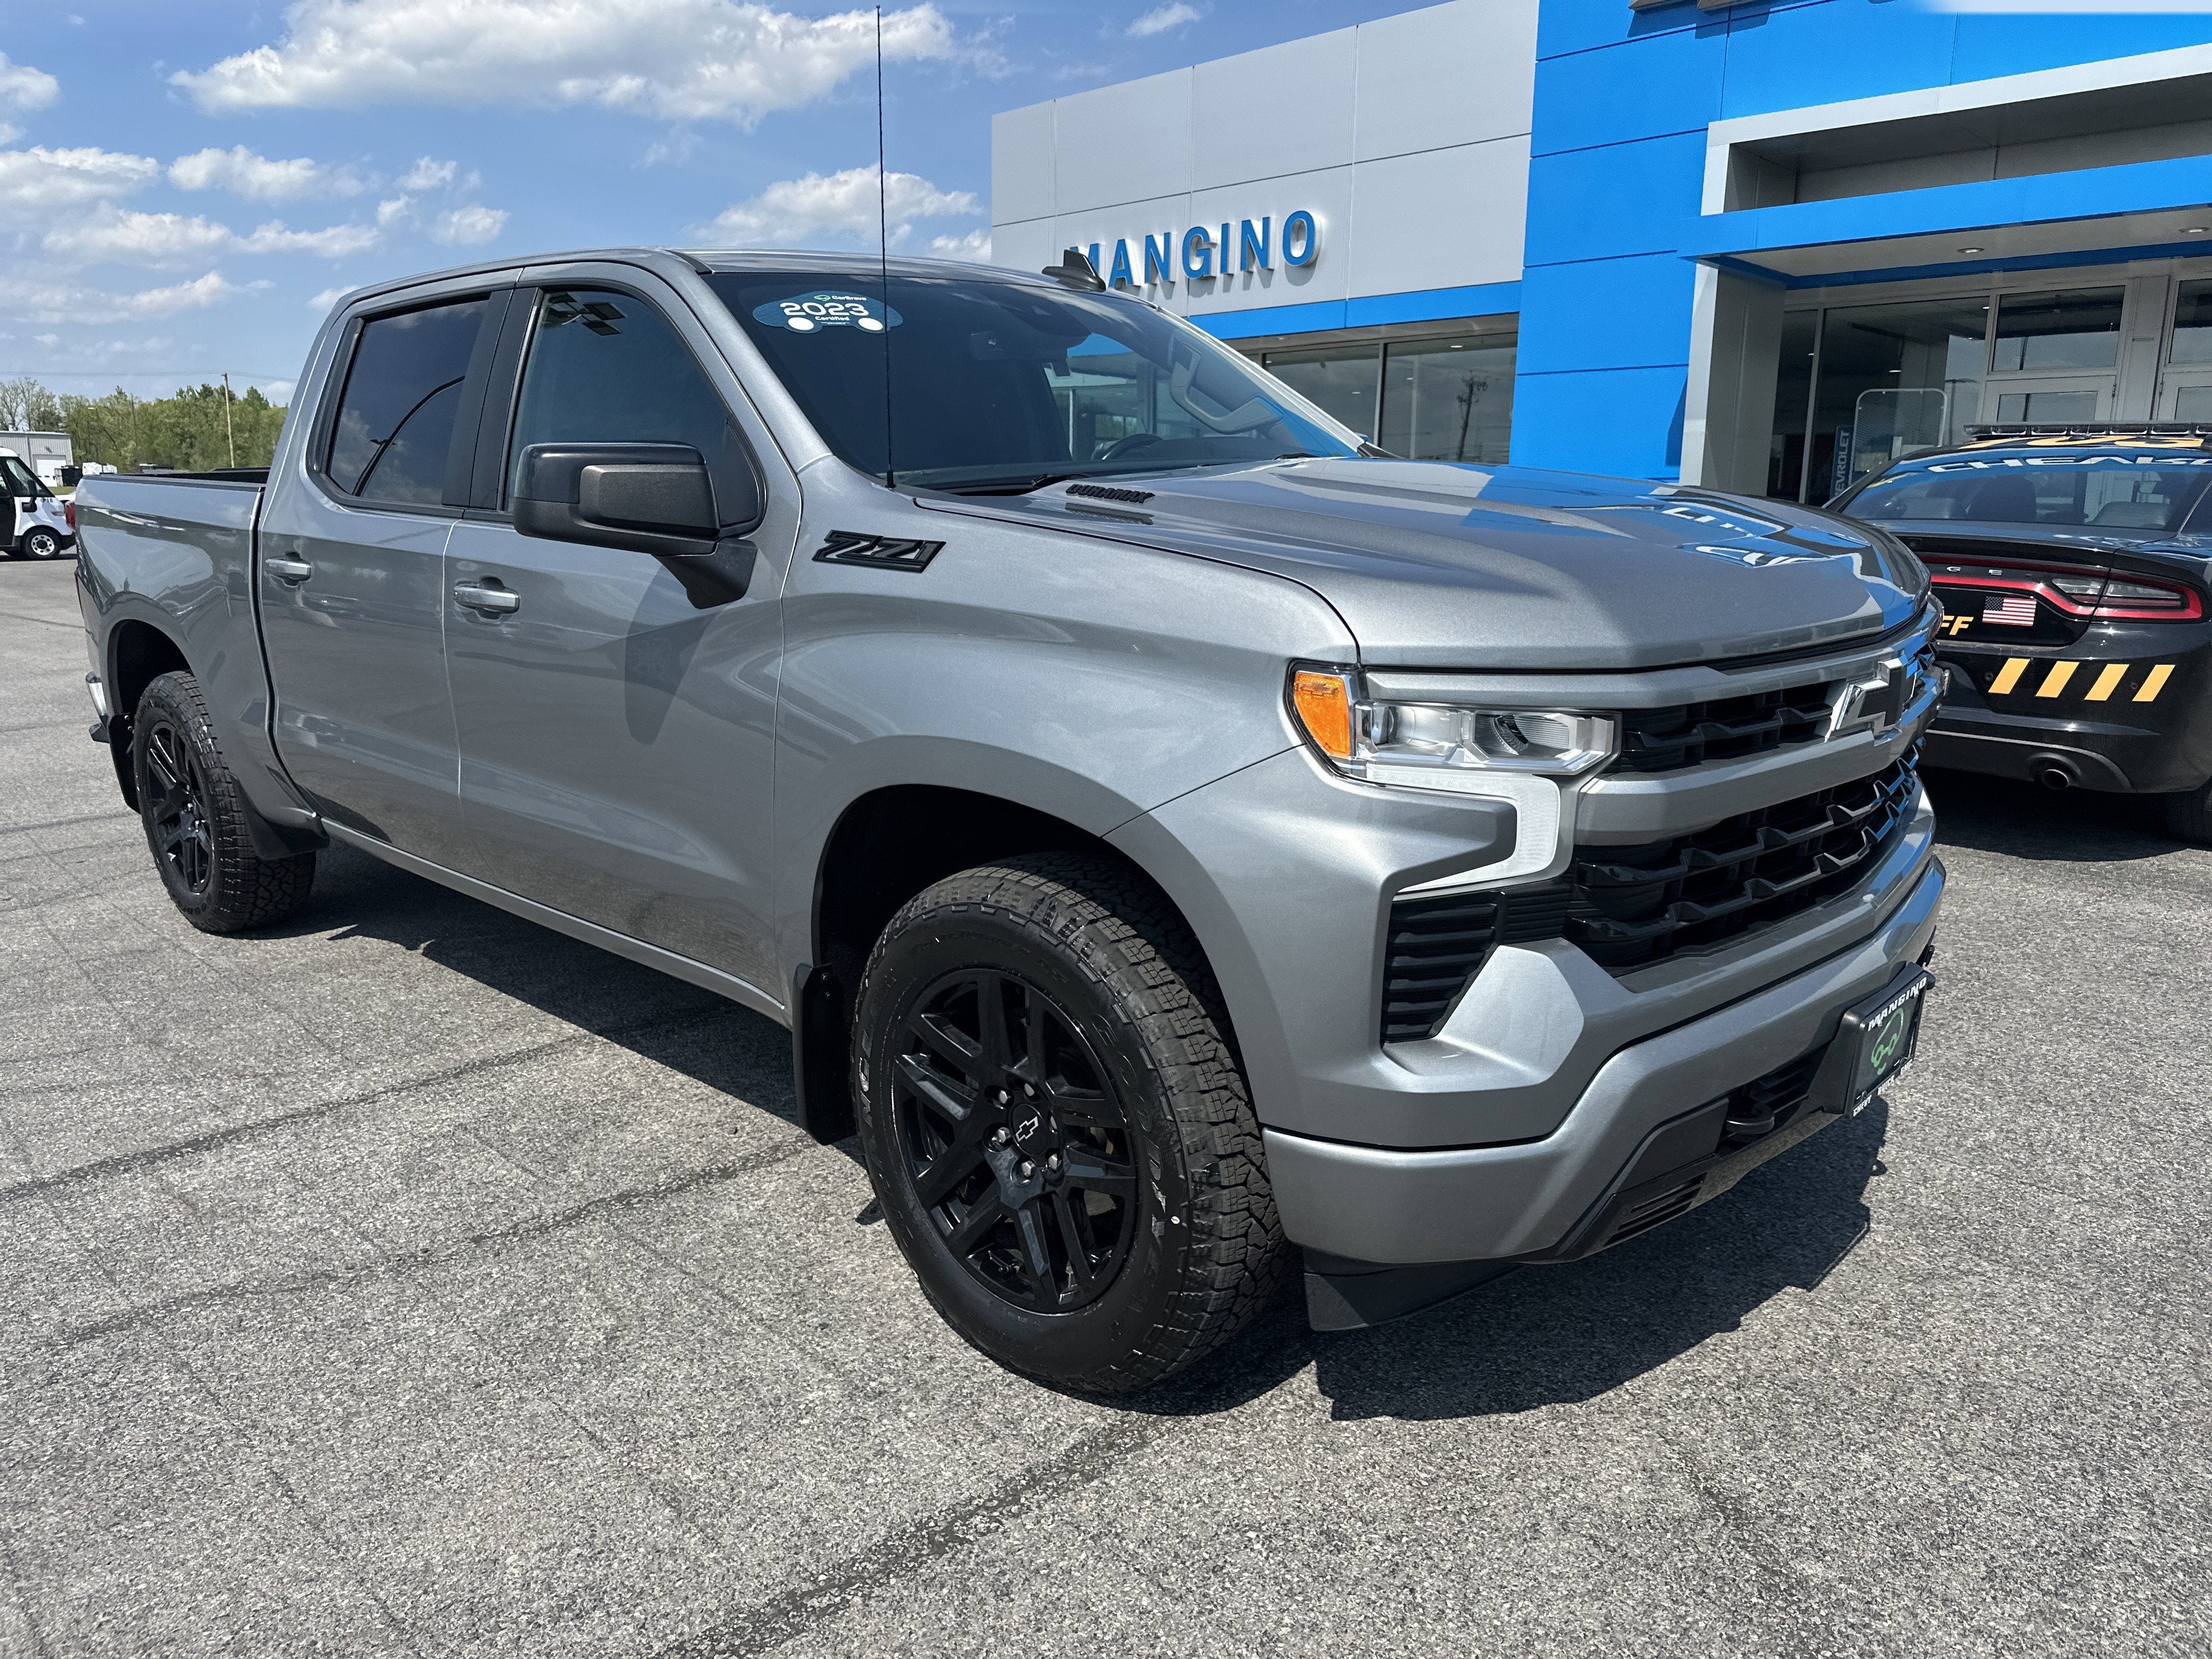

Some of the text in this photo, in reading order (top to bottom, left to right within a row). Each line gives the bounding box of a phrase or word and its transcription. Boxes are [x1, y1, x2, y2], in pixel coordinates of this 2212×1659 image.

[780, 302, 869, 316] 2023
[1835, 430, 1850, 496] EVROLET
[1066, 483, 1155, 504] DURAMAX
[811, 529, 947, 574] Z71
[1867, 977, 1927, 1031] MANGINO
